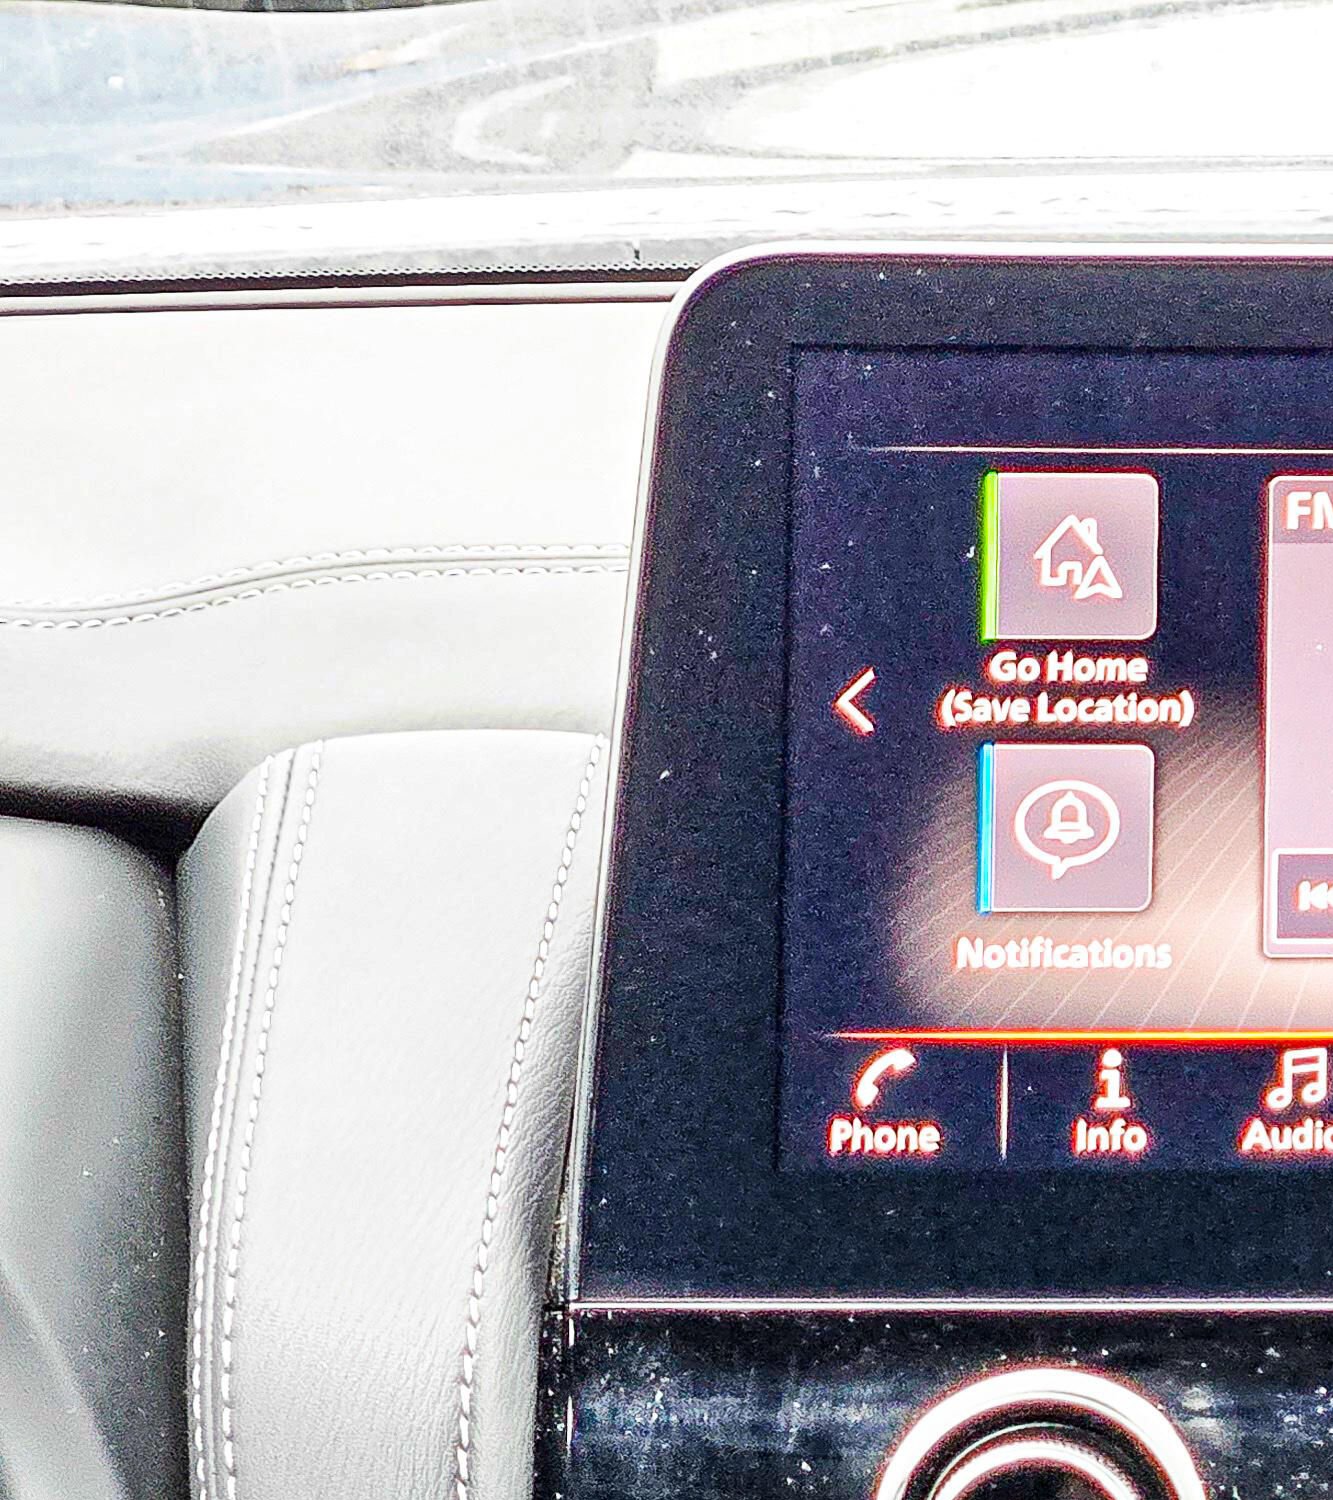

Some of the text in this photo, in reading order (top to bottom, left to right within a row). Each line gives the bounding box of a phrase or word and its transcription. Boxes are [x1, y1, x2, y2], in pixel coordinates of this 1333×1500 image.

[989, 652, 1148, 683] Go Home
[940, 690, 1194, 725] (Save Location)
[956, 937, 1172, 970] Notifications
[829, 1118, 941, 1155] Phone
[1075, 1119, 1147, 1153] Info
